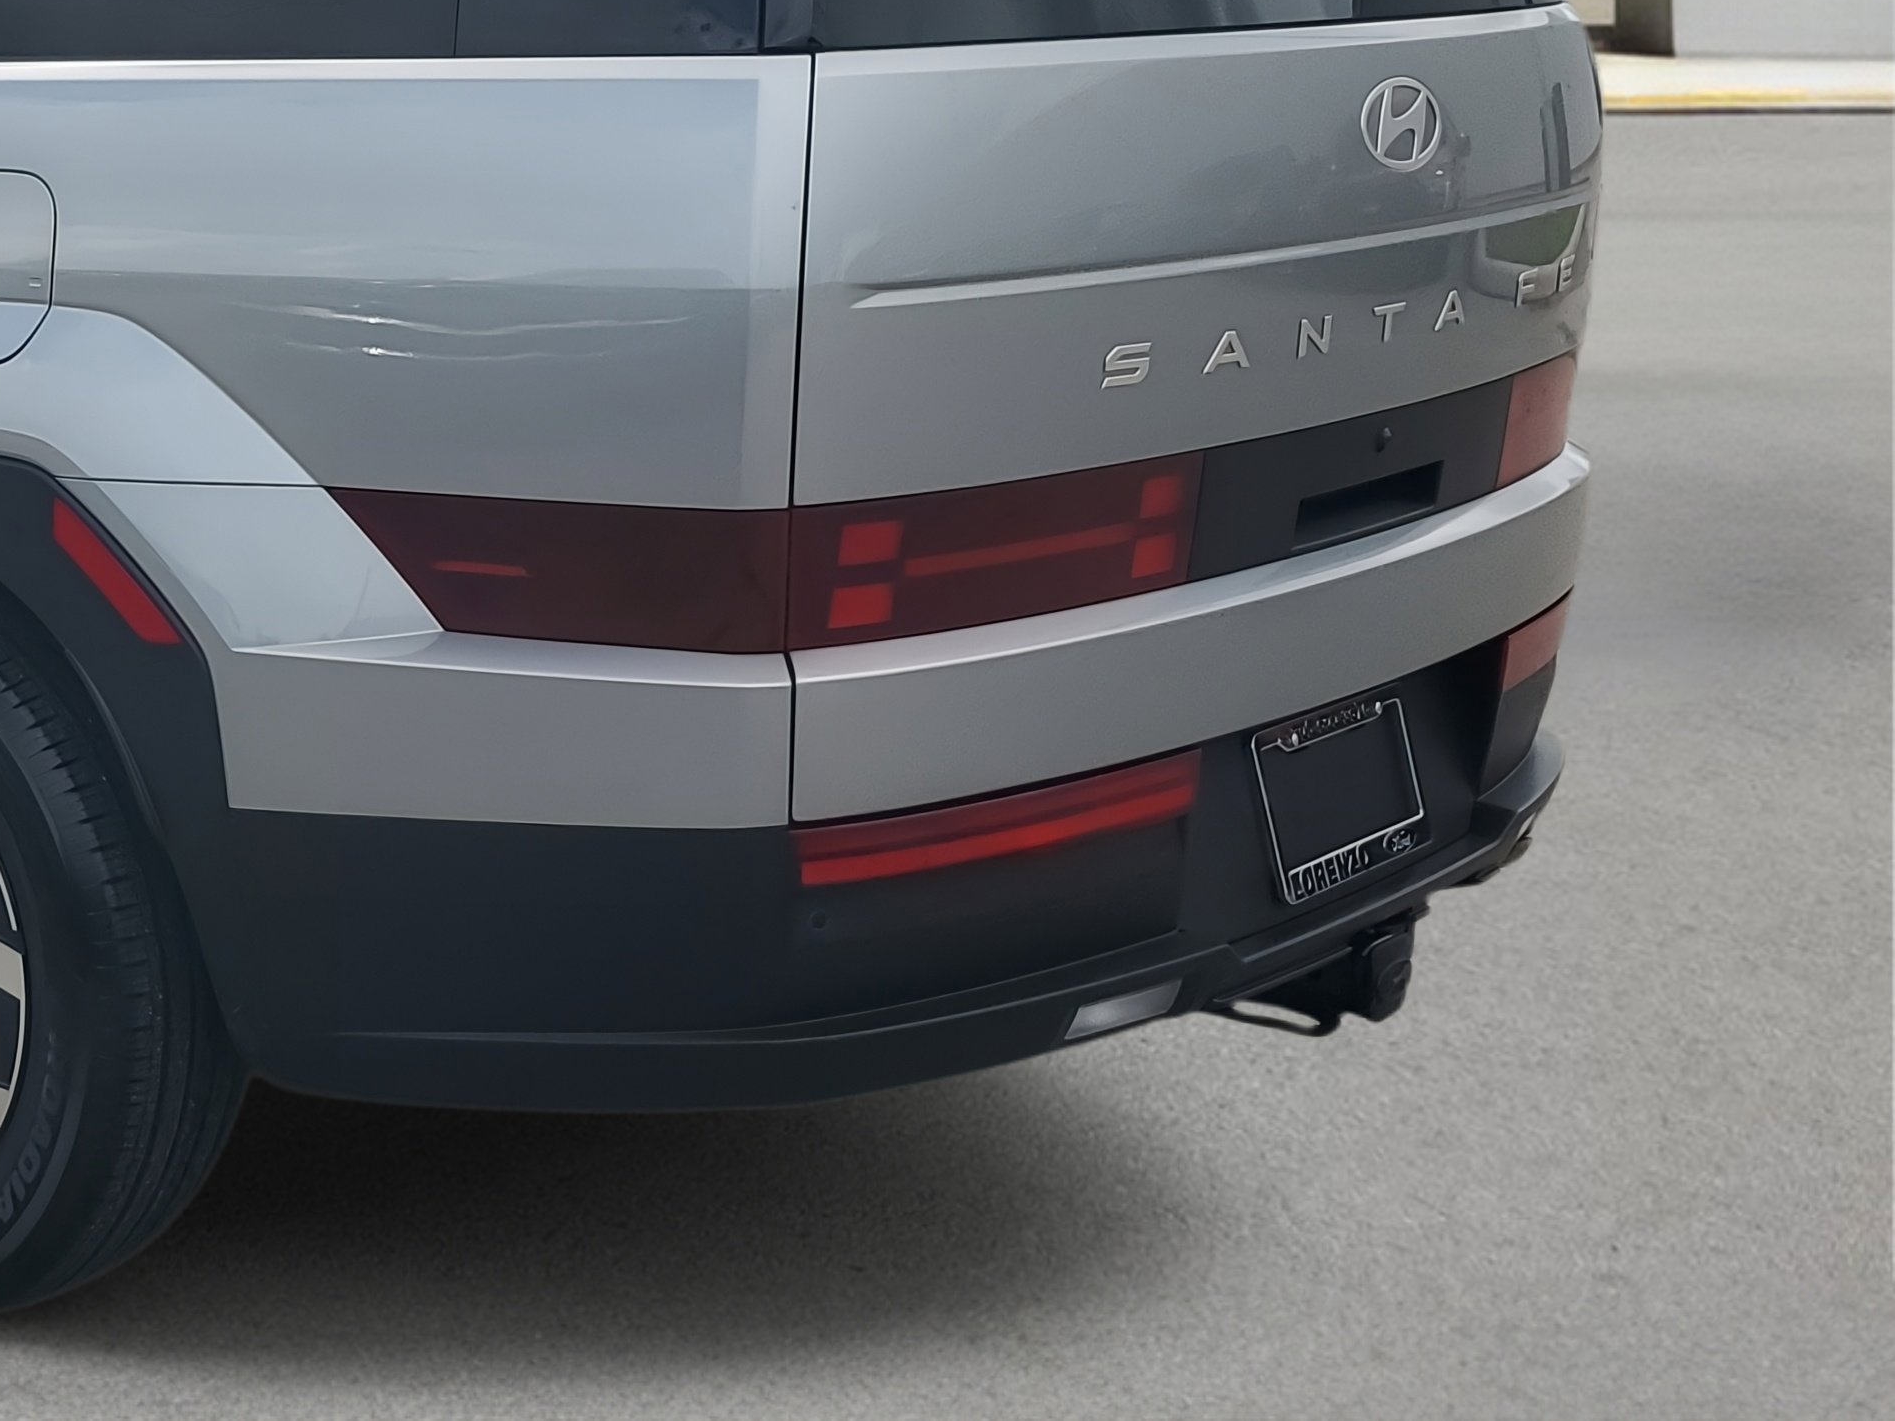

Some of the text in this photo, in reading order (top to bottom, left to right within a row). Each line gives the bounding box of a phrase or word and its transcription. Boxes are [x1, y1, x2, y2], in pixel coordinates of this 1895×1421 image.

[1100, 254, 1576, 390] SANTA FE
[1289, 845, 1370, 903] LORENZO
